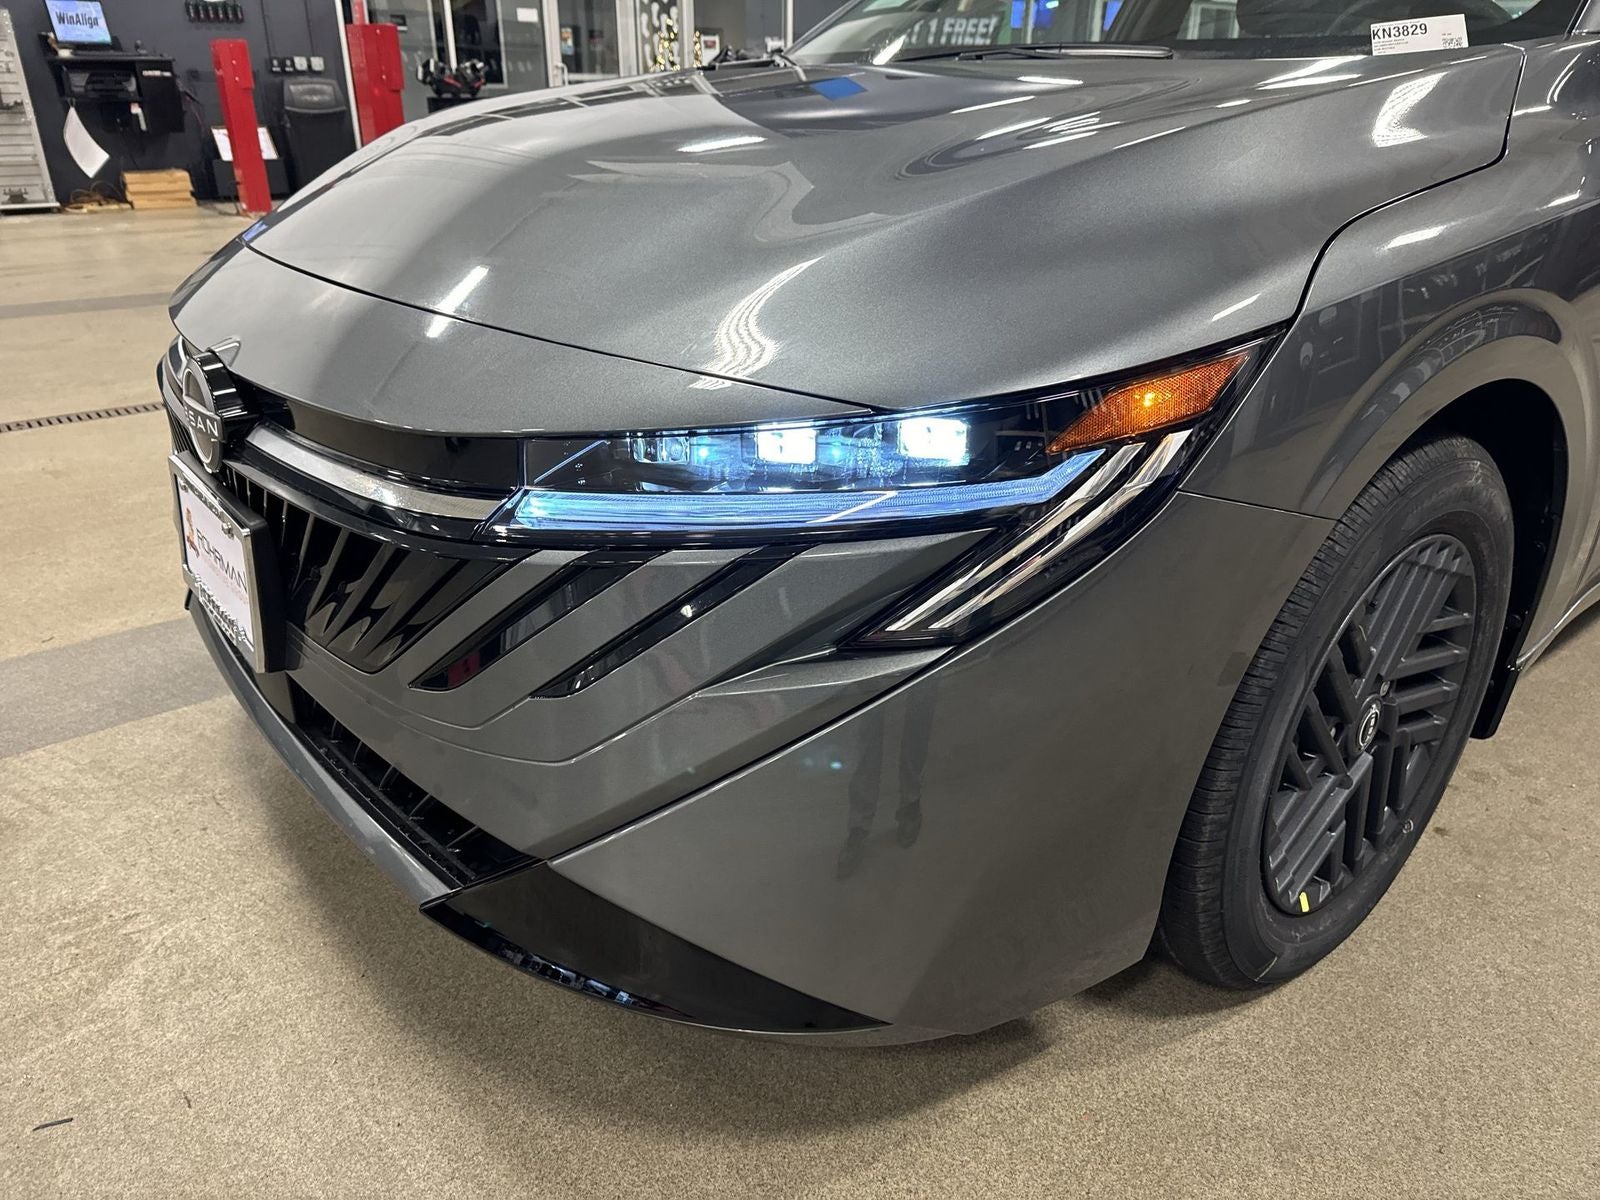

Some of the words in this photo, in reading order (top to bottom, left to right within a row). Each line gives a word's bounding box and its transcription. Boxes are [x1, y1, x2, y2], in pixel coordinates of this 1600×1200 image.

[55, 11, 99, 29] WinAlign
[940, 13, 999, 46] FREE!
[1372, 23, 1428, 41] KN3829
